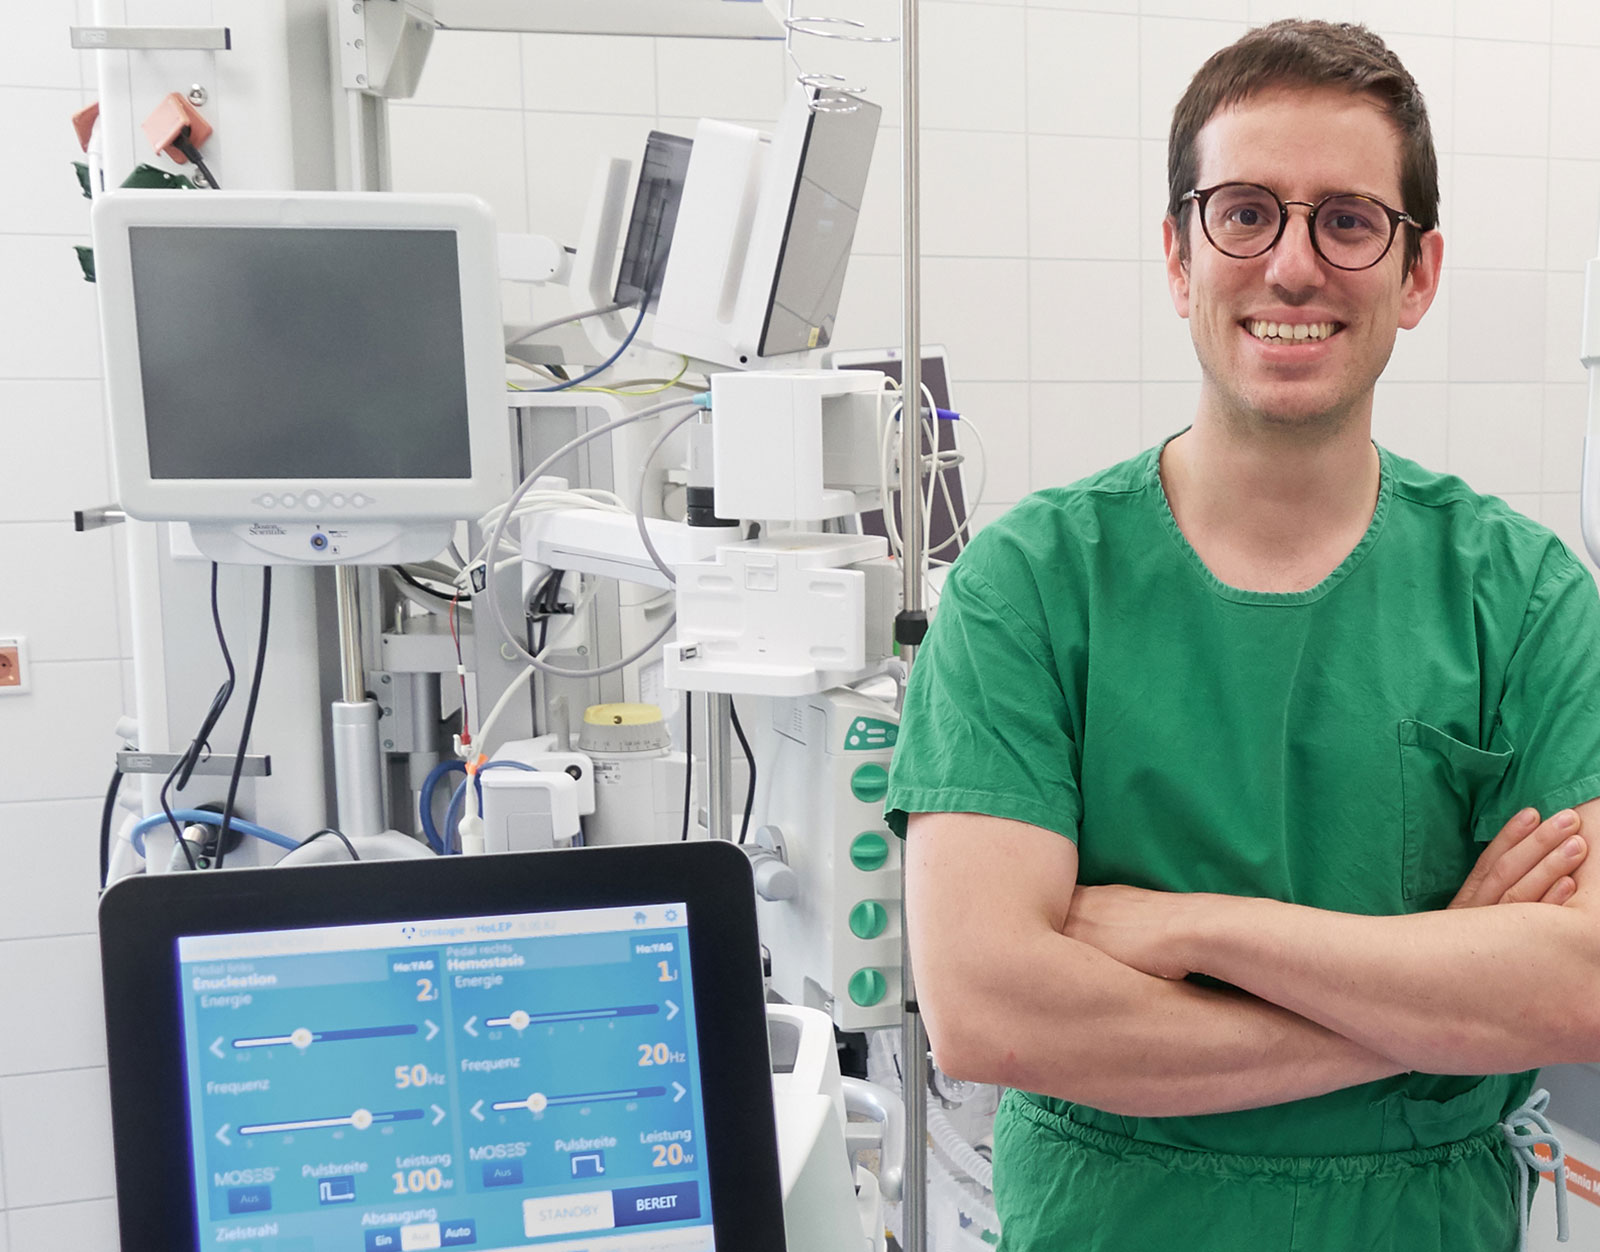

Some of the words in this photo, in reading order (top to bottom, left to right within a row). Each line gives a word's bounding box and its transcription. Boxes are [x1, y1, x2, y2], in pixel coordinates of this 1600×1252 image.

[447, 953, 525, 971] Hemostasis
[193, 973, 277, 990] Enucleation
[455, 974, 503, 989] Energie
[201, 993, 252, 1009] Energie
[461, 1056, 521, 1072] Frequenz
[206, 1079, 270, 1096] Frequenz
[555, 1136, 616, 1152] Pulsbreite
[640, 1129, 691, 1145] Leistung
[302, 1161, 368, 1177] Pulsbreite
[396, 1153, 451, 1169] Leistung
[494, 1168, 512, 1177] Aus
[1564, 1166, 1591, 1190] Omnia
[539, 1204, 599, 1221] STANDBY
[636, 1195, 677, 1211] BEREIT
[361, 1207, 437, 1226] Absaugung
[216, 1222, 278, 1242] Zielstrahl
[375, 1235, 392, 1246] Ein
[445, 1227, 470, 1238] Auto
